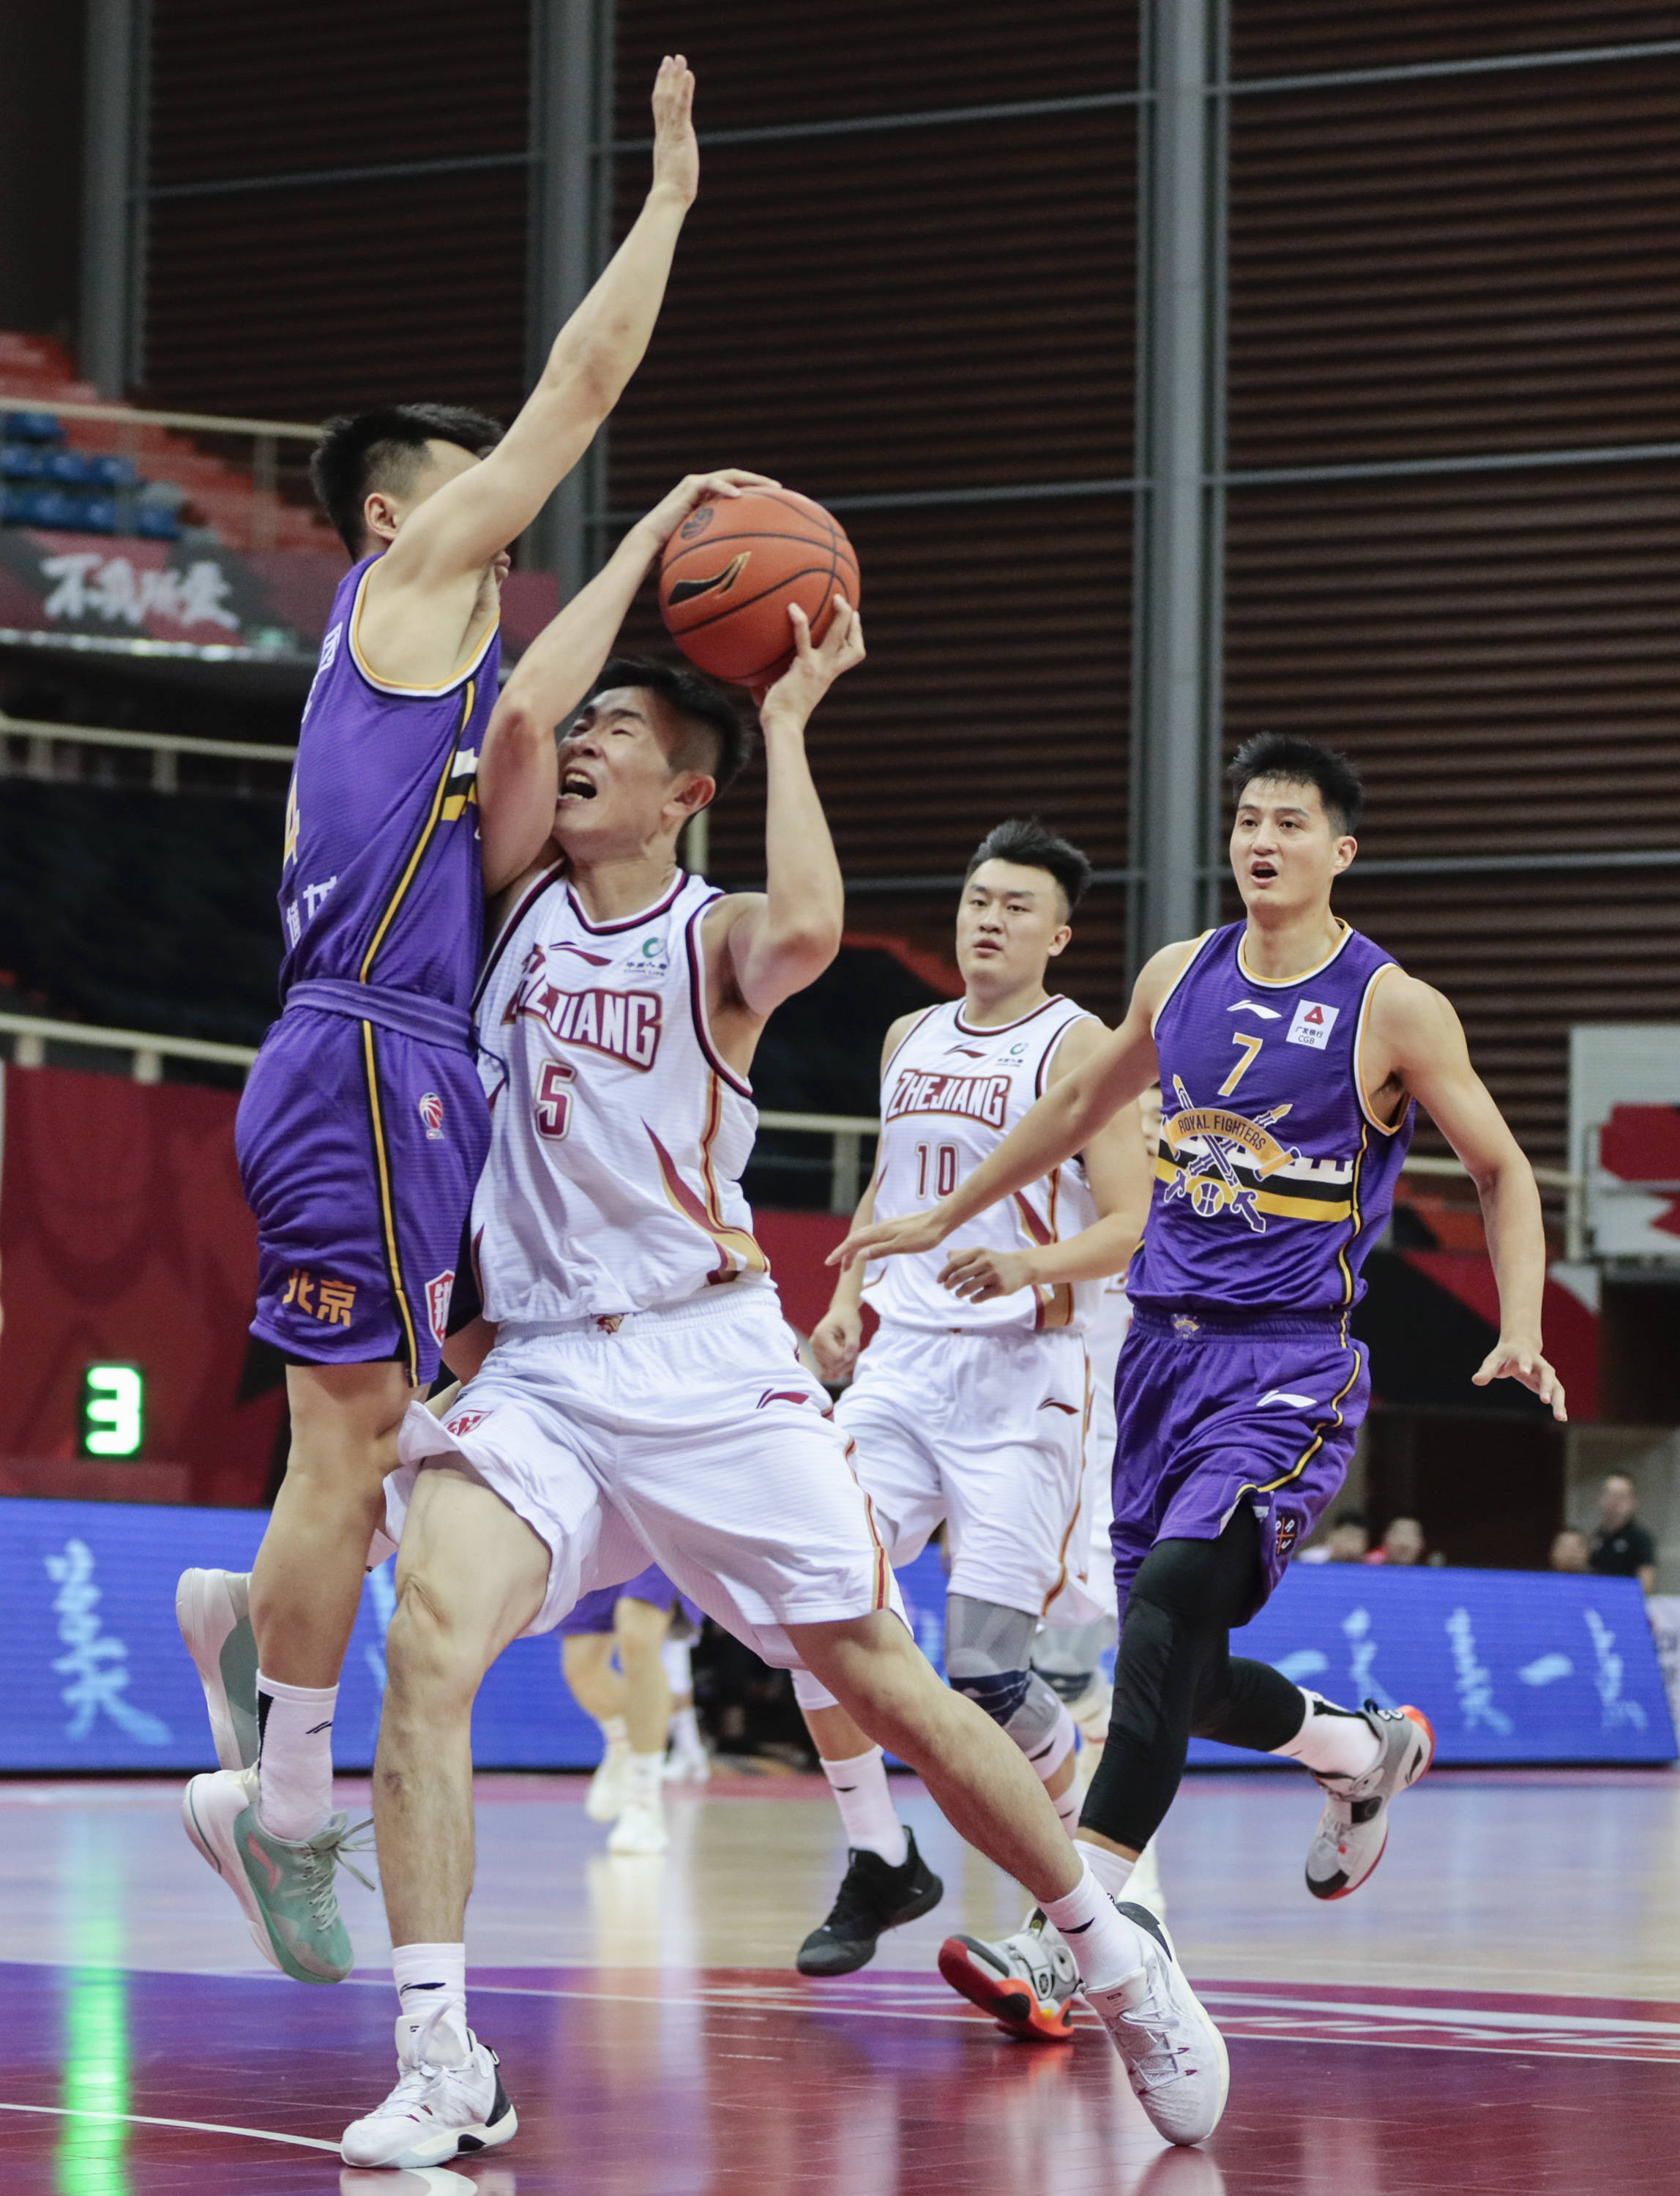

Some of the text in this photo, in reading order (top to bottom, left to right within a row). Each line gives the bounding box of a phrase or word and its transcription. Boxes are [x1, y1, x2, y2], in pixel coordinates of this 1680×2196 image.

[502, 944, 662, 1074] EJIANG
[1217, 1032, 1263, 1097] 7
[1298, 1035, 1315, 1045] CGB
[535, 1059, 578, 1140] 5
[886, 1069, 1012, 1130] ZHEJIANG
[1178, 1114, 1266, 1151] ROYAL FIGHTERS
[916, 1142, 960, 1200] 10
[281, 1267, 357, 1327] 北京
[86, 1367, 143, 1454] 3
